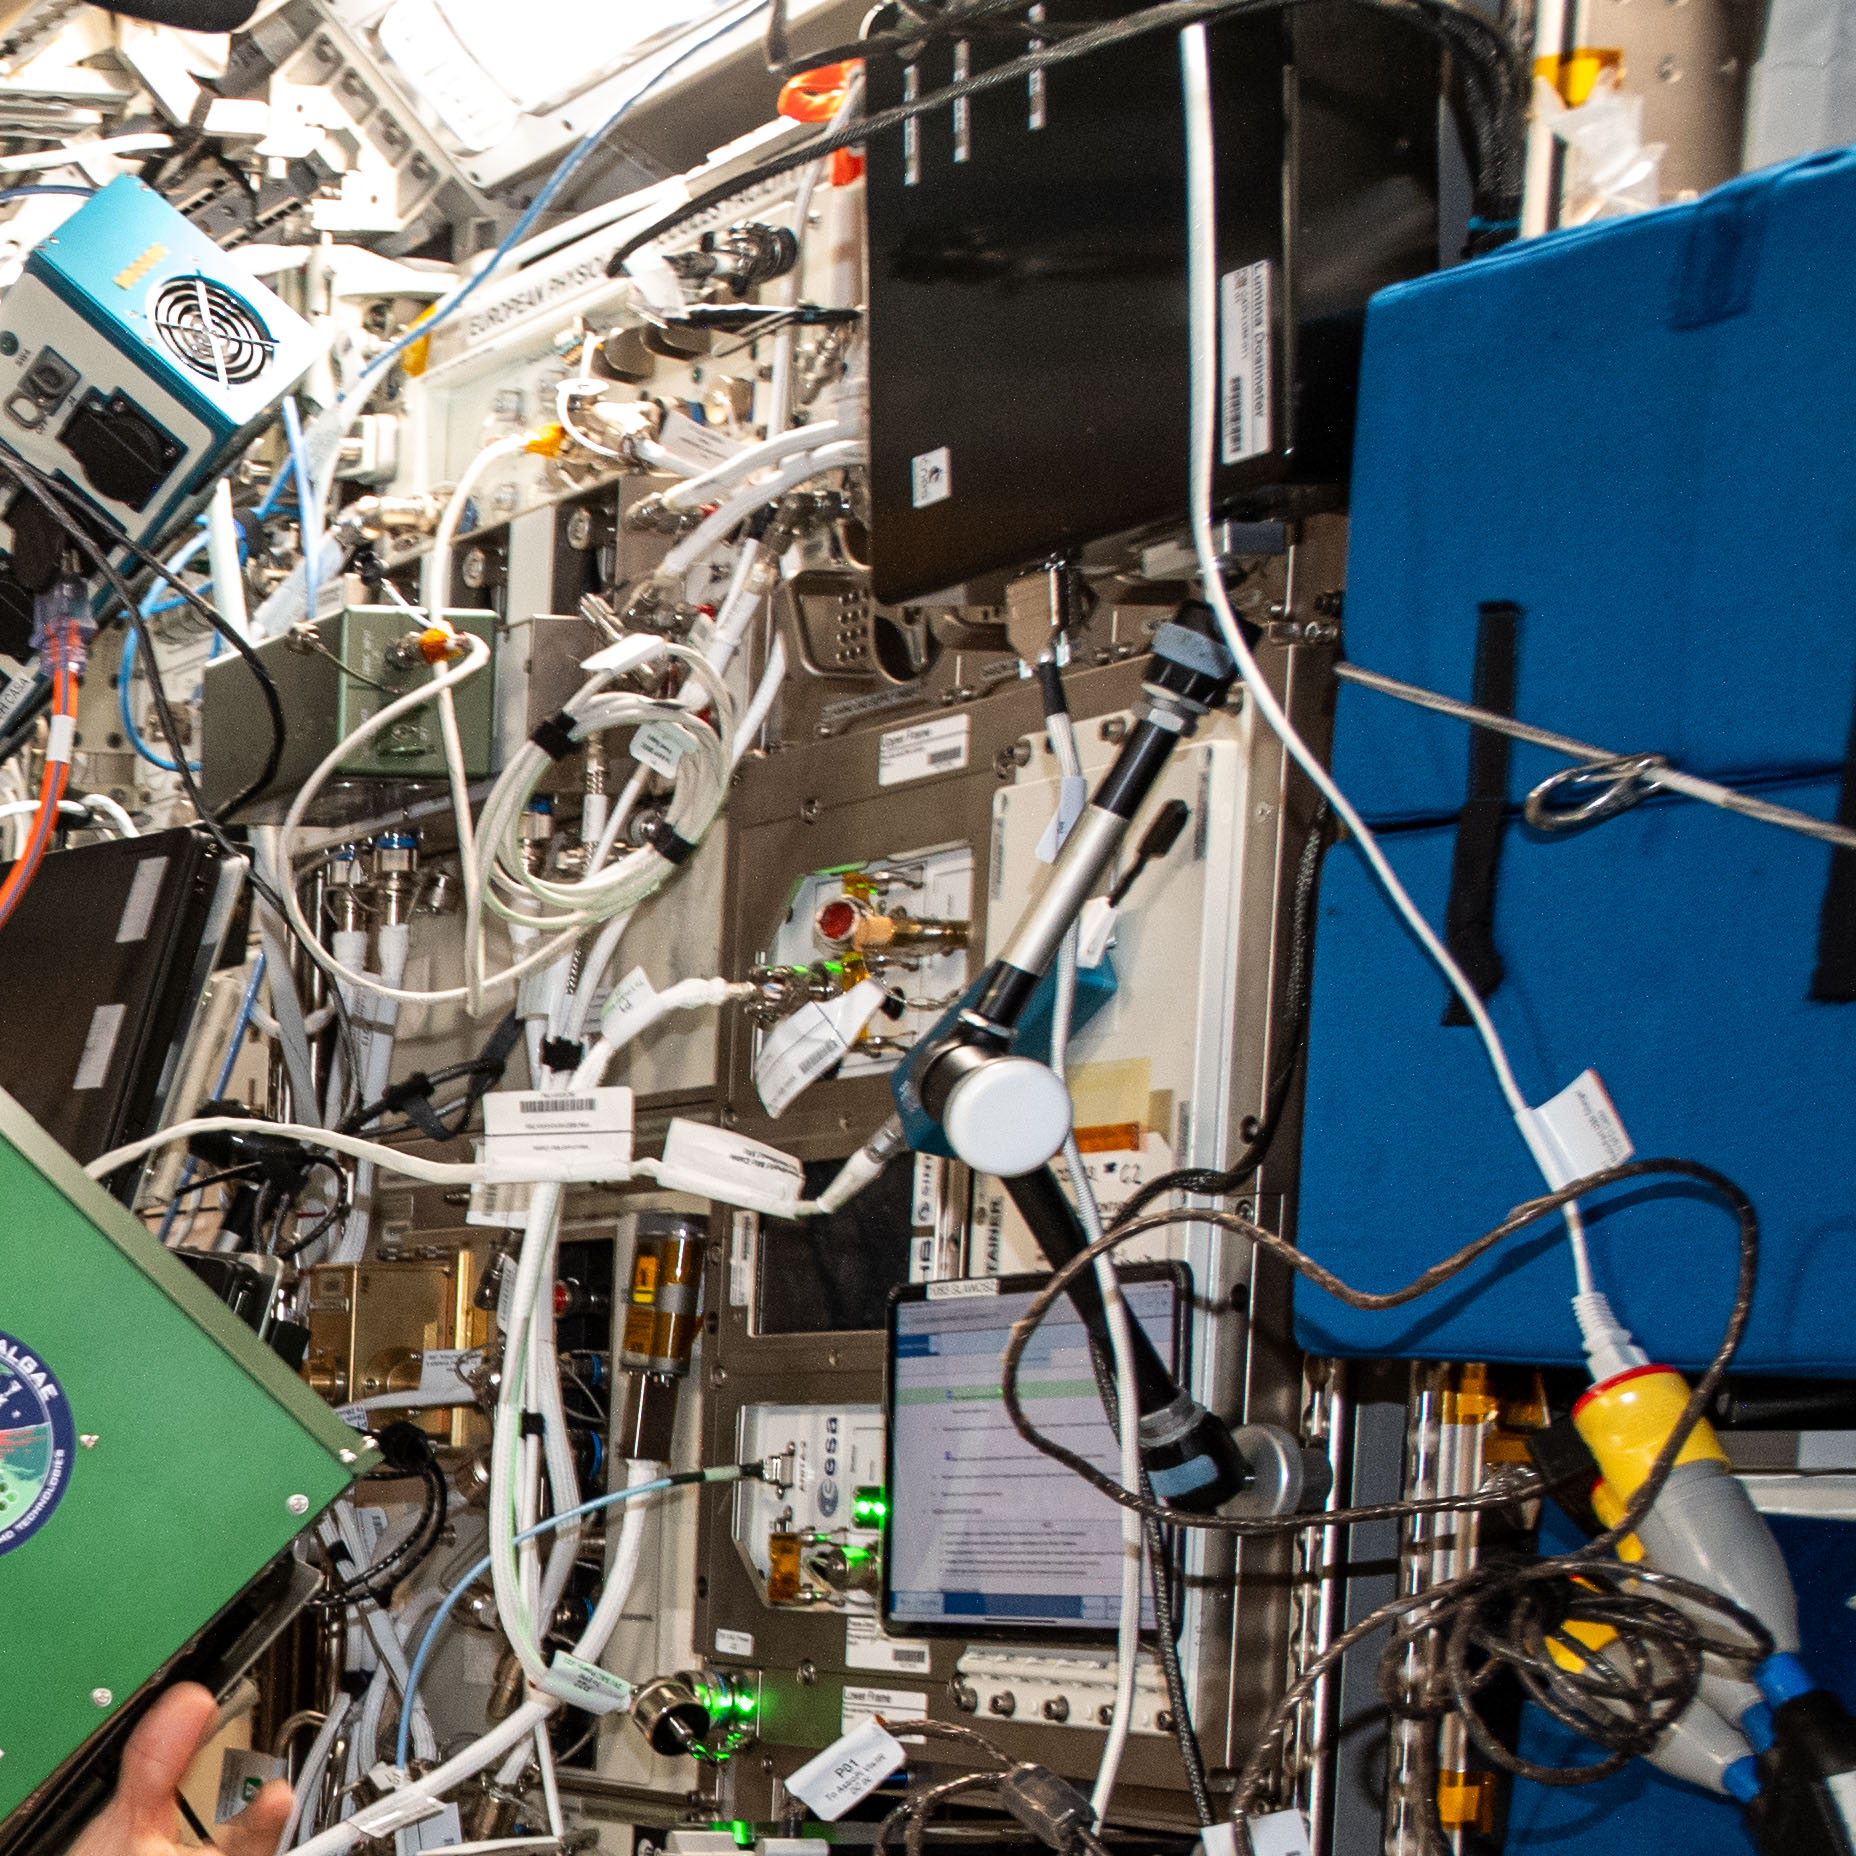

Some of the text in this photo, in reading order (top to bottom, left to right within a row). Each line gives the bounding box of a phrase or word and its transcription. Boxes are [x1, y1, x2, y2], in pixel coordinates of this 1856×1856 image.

[1252, 263, 1265, 417] Lumina Dosimeter
[1, 675, 31, 707] CASA
[821, 1416, 839, 1476] esa
[15, 1448, 65, 1531] TECHNOLOGIES
[843, 1690, 892, 1703] Lower Frame
[832, 1755, 861, 1780] P01
